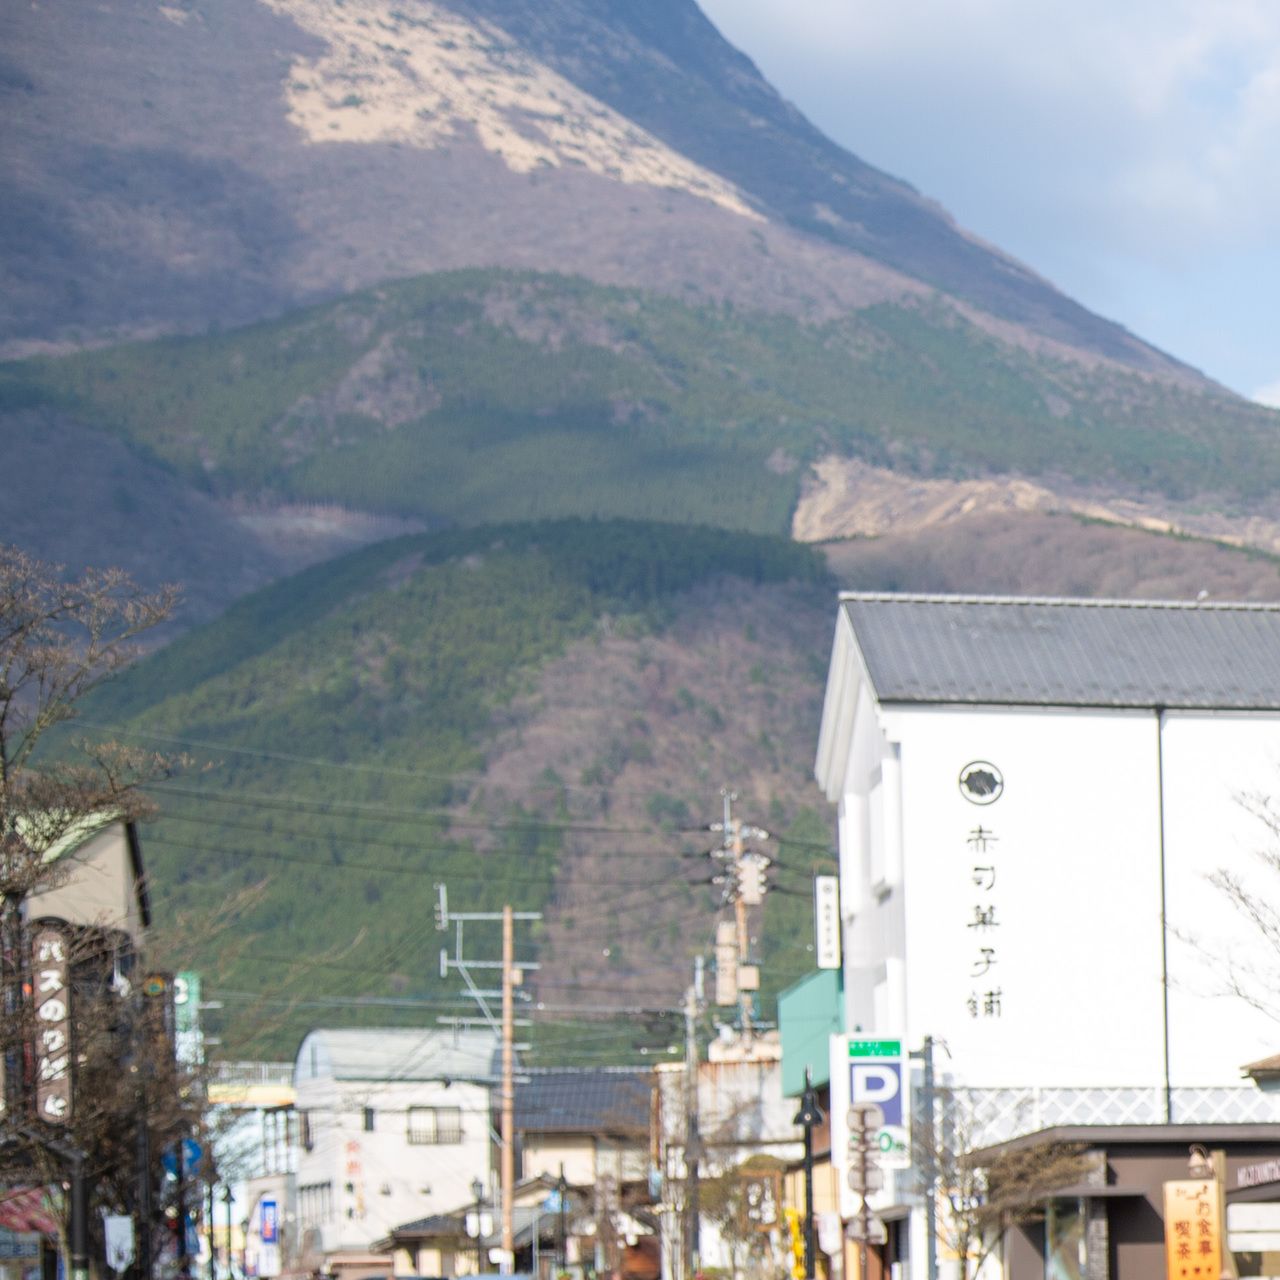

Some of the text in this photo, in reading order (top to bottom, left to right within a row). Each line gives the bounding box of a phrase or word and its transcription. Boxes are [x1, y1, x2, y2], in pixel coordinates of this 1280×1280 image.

[966, 824, 1003, 1019] 赤司菓子舗
[852, 1064, 900, 1104] P
[1196, 1201, 1213, 1258] お食事
